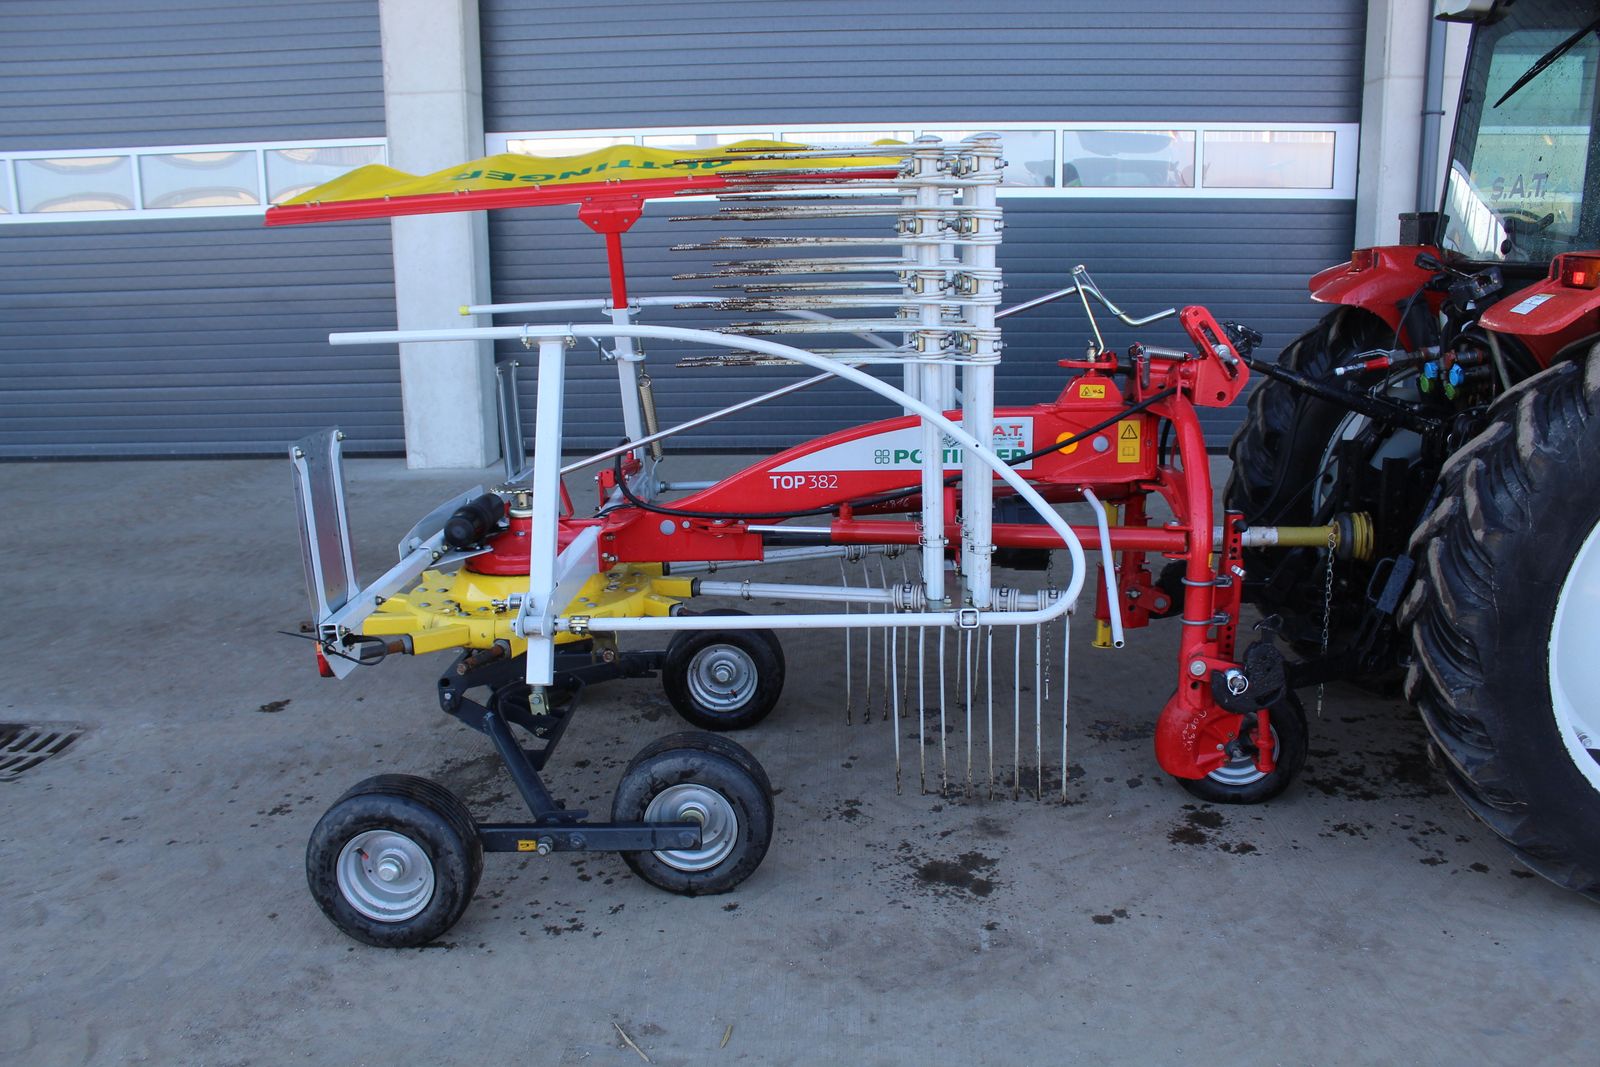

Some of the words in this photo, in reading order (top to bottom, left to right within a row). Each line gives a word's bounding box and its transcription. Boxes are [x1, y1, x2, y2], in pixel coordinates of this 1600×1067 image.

[993, 424, 1023, 436] A.T.
[769, 475, 806, 489] TOP
[808, 474, 838, 489] 382
